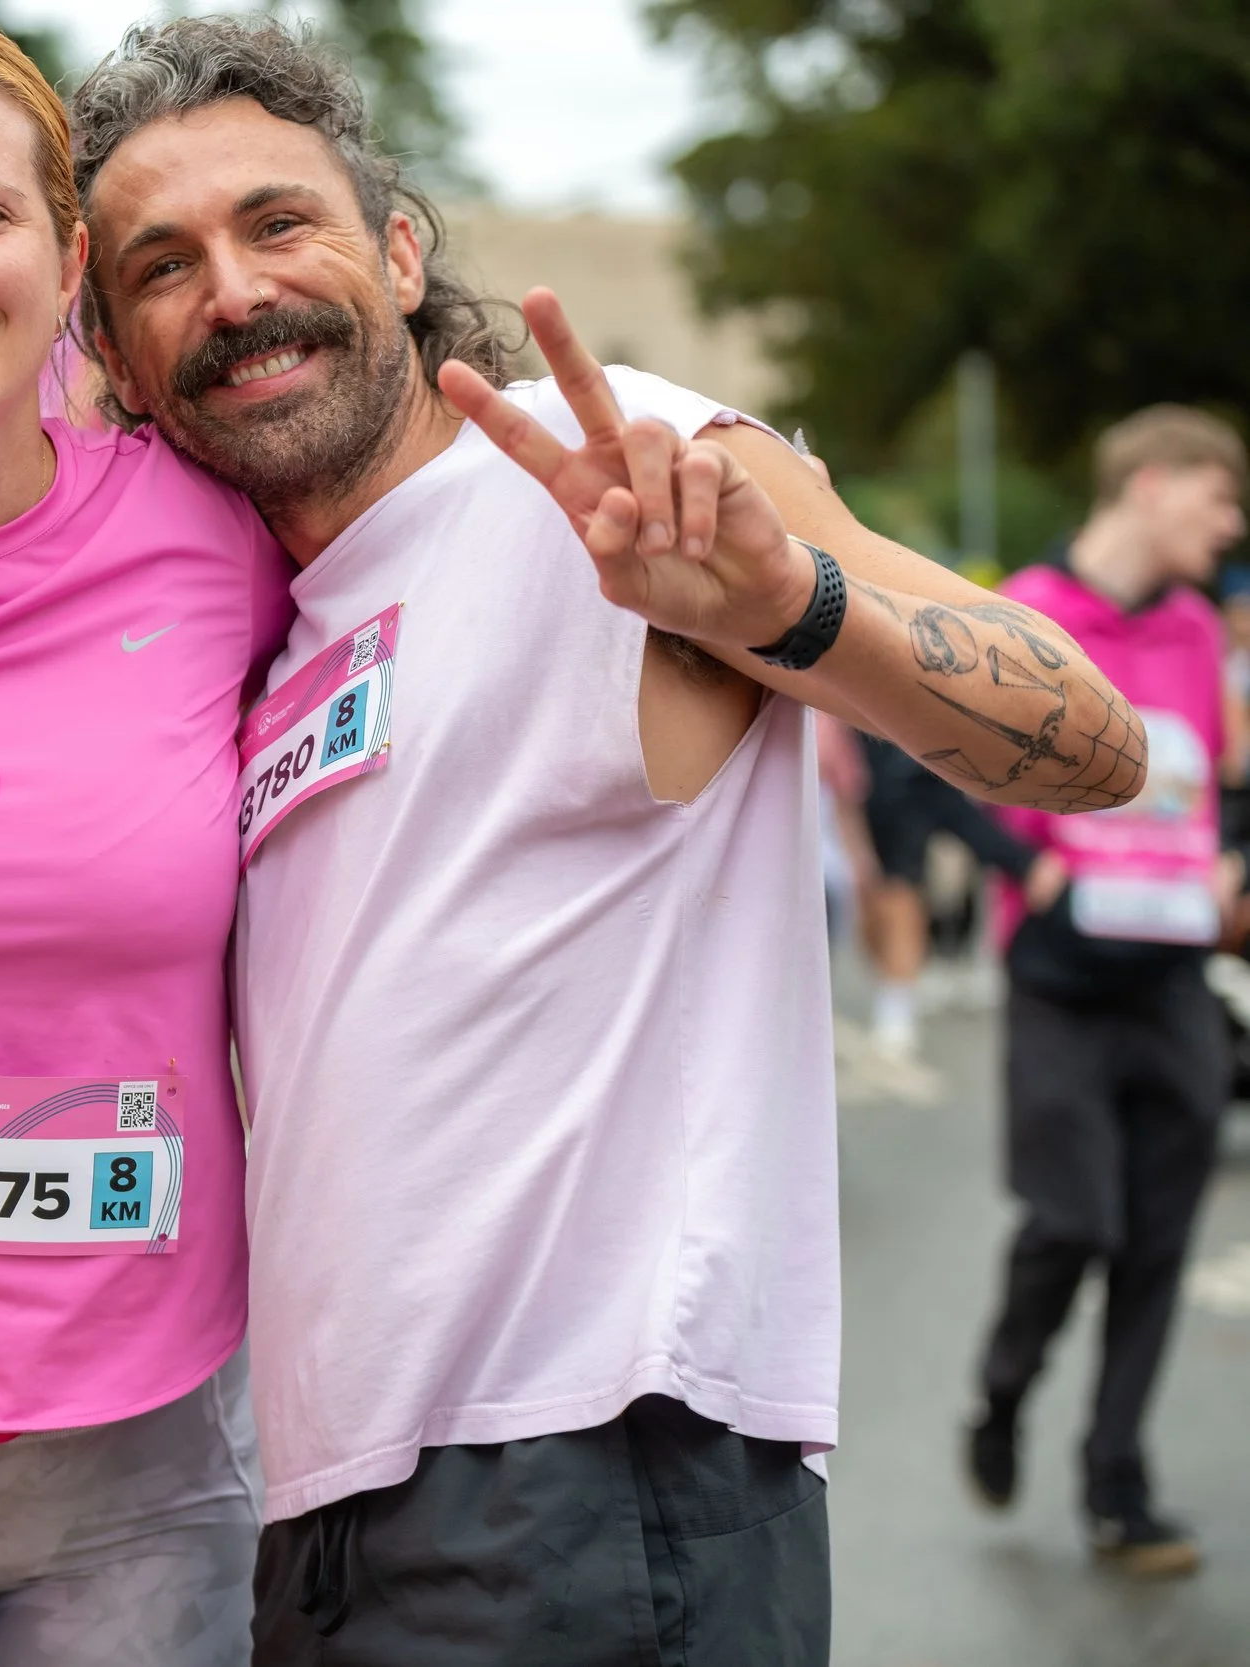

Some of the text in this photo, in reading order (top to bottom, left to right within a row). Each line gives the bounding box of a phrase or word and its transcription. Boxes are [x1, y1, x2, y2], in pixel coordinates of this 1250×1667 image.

[335, 693, 357, 728] 8
[327, 728, 357, 758] KM
[239, 734, 315, 836] 3780
[109, 1157, 137, 1192] 8
[101, 1201, 141, 1221] KM
